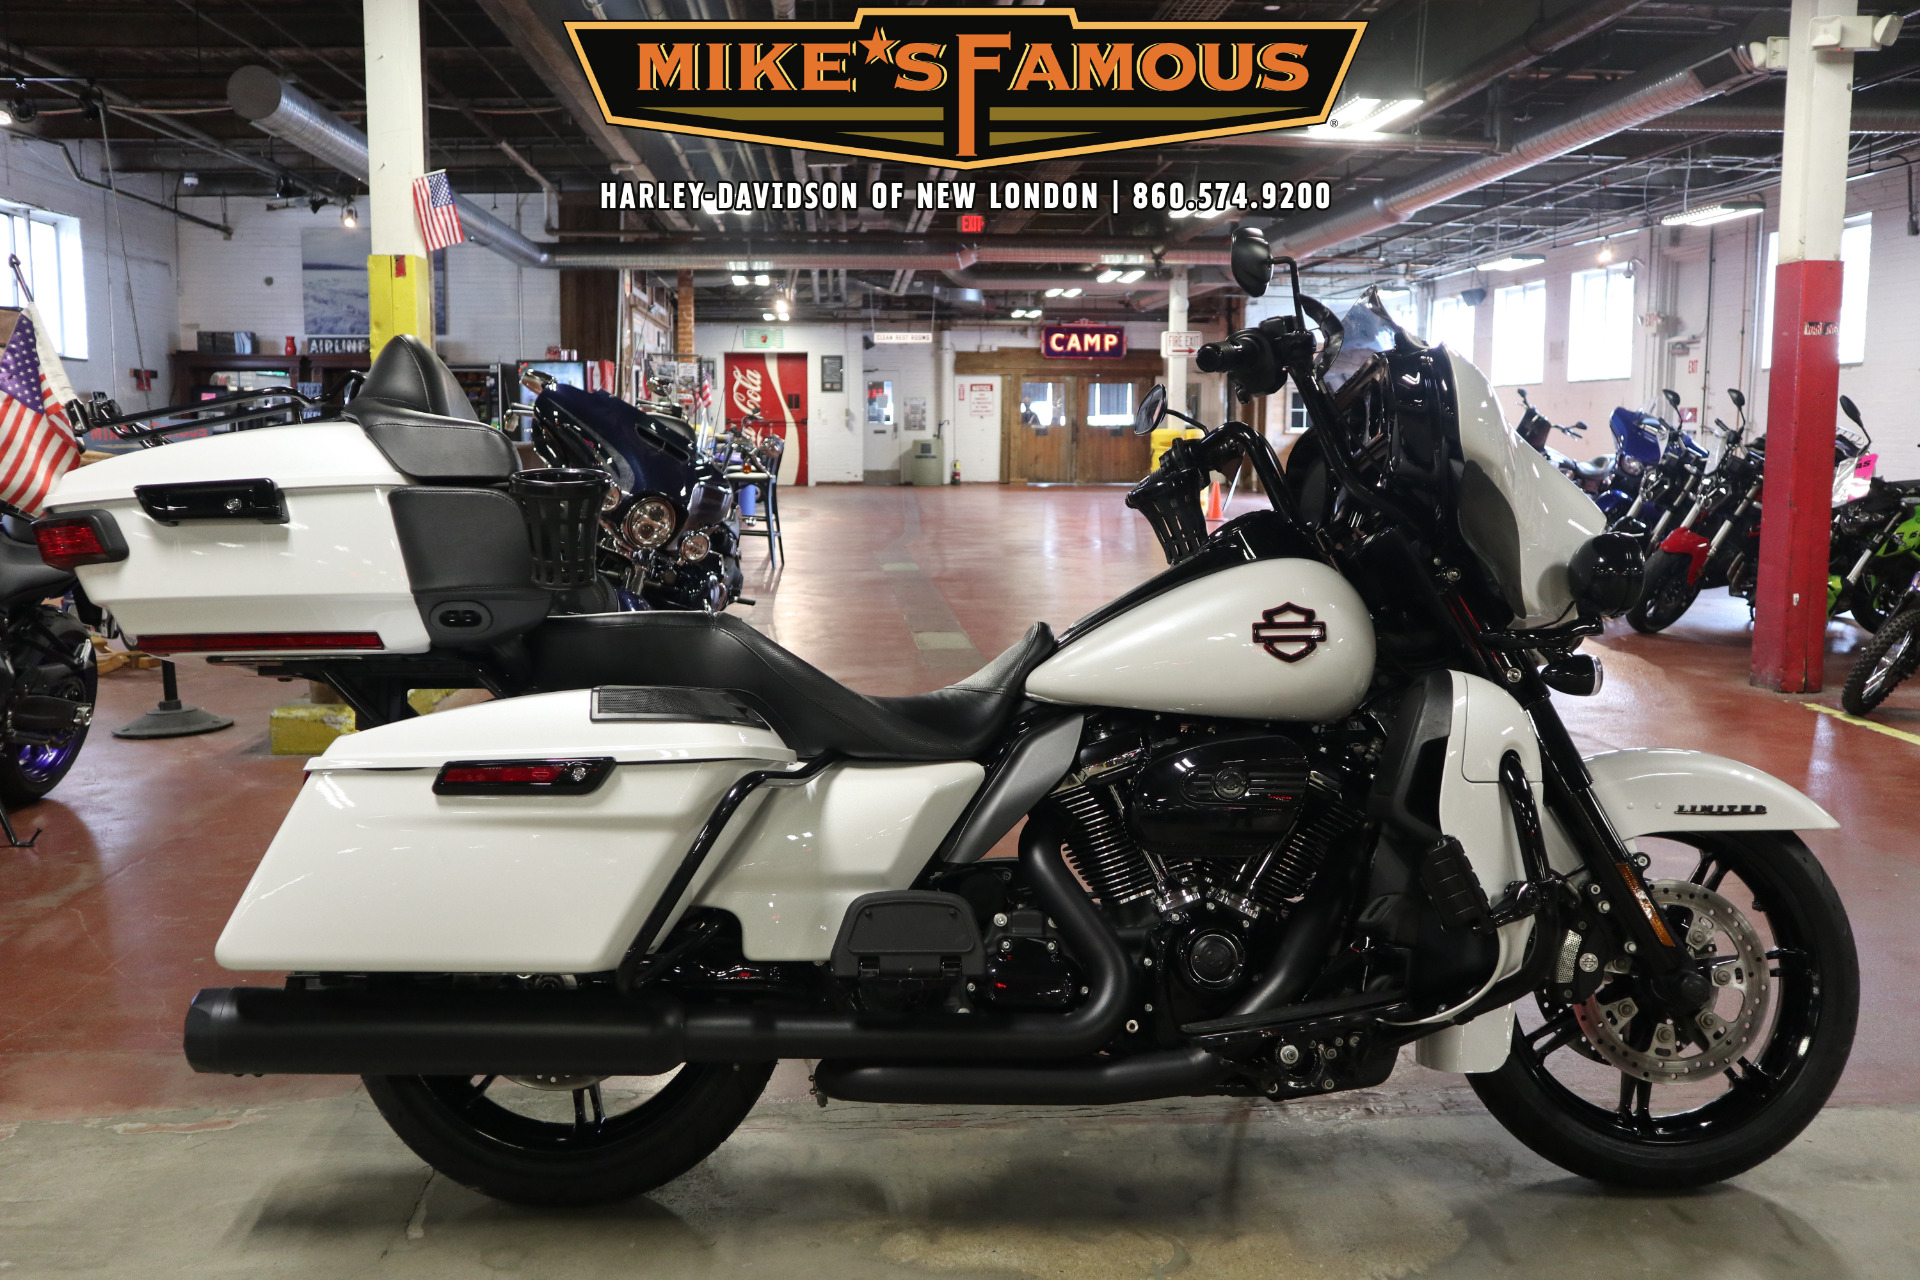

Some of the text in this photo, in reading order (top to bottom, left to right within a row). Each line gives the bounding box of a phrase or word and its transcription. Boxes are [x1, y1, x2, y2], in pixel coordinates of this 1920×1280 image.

[962, 216, 983, 232] EXIT
[1050, 333, 1118, 352] CAMP
[1168, 335, 1200, 347] FIRE EXIT
[1688, 360, 1698, 374] EXIT
[1677, 804, 1767, 814] LIMITED
